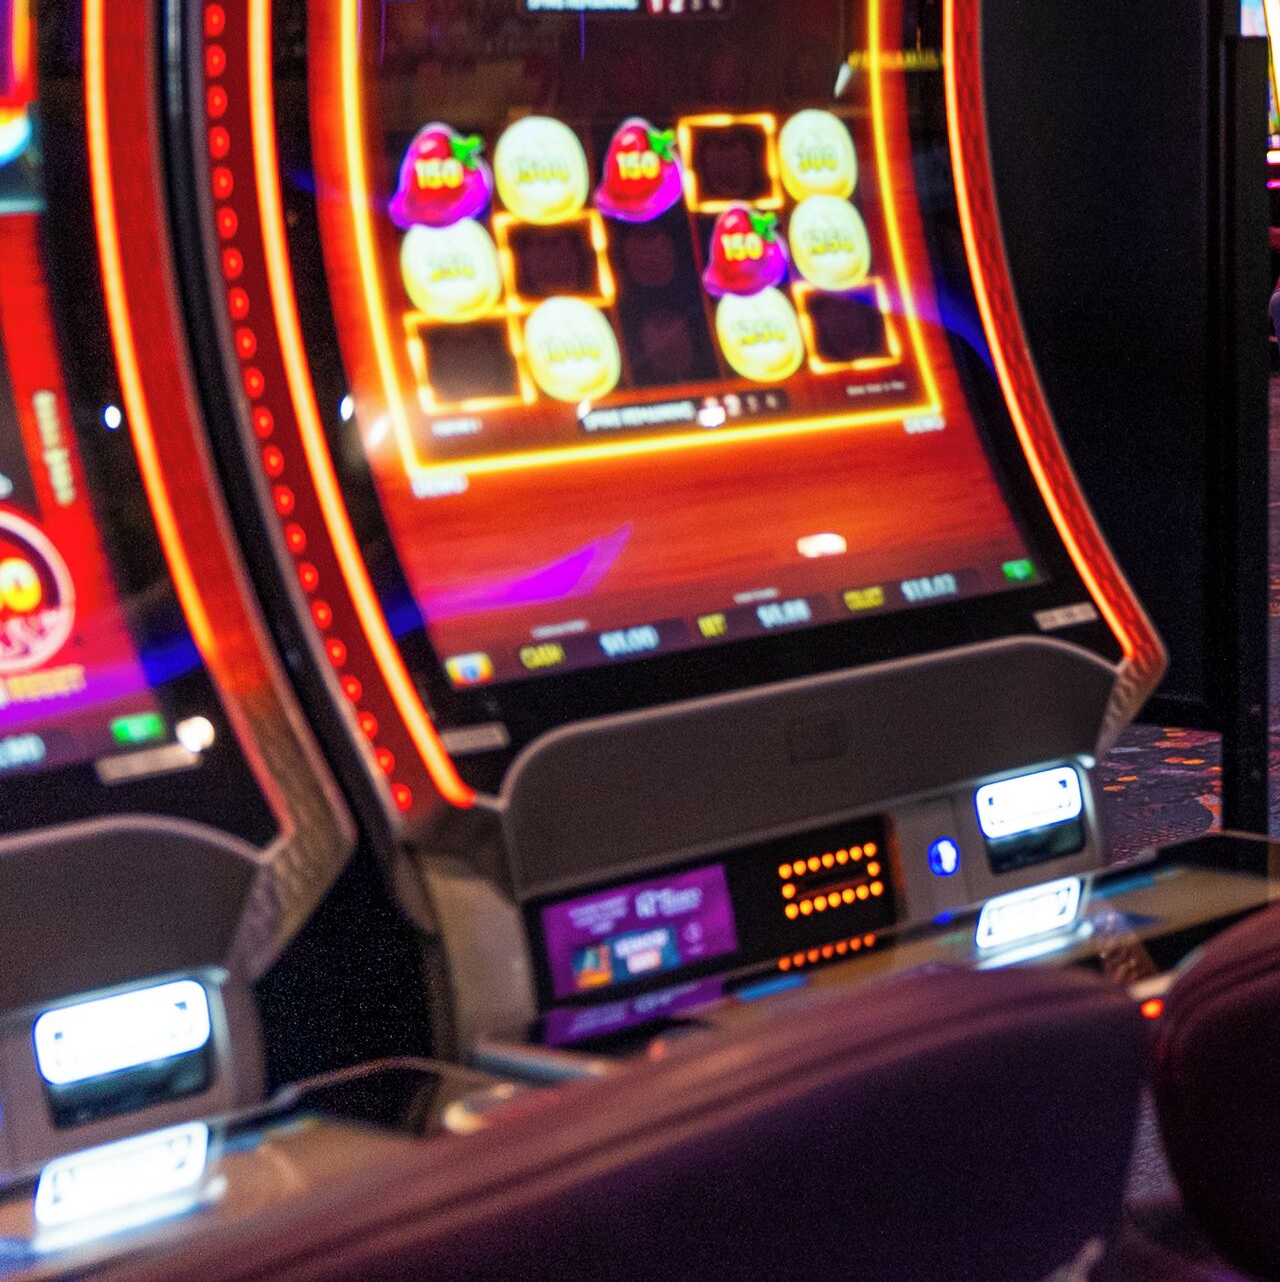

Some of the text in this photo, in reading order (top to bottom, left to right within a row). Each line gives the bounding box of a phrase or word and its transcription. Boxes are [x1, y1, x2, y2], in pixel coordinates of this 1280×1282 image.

[414, 150, 661, 190] 150 150
[721, 231, 765, 261] 150
